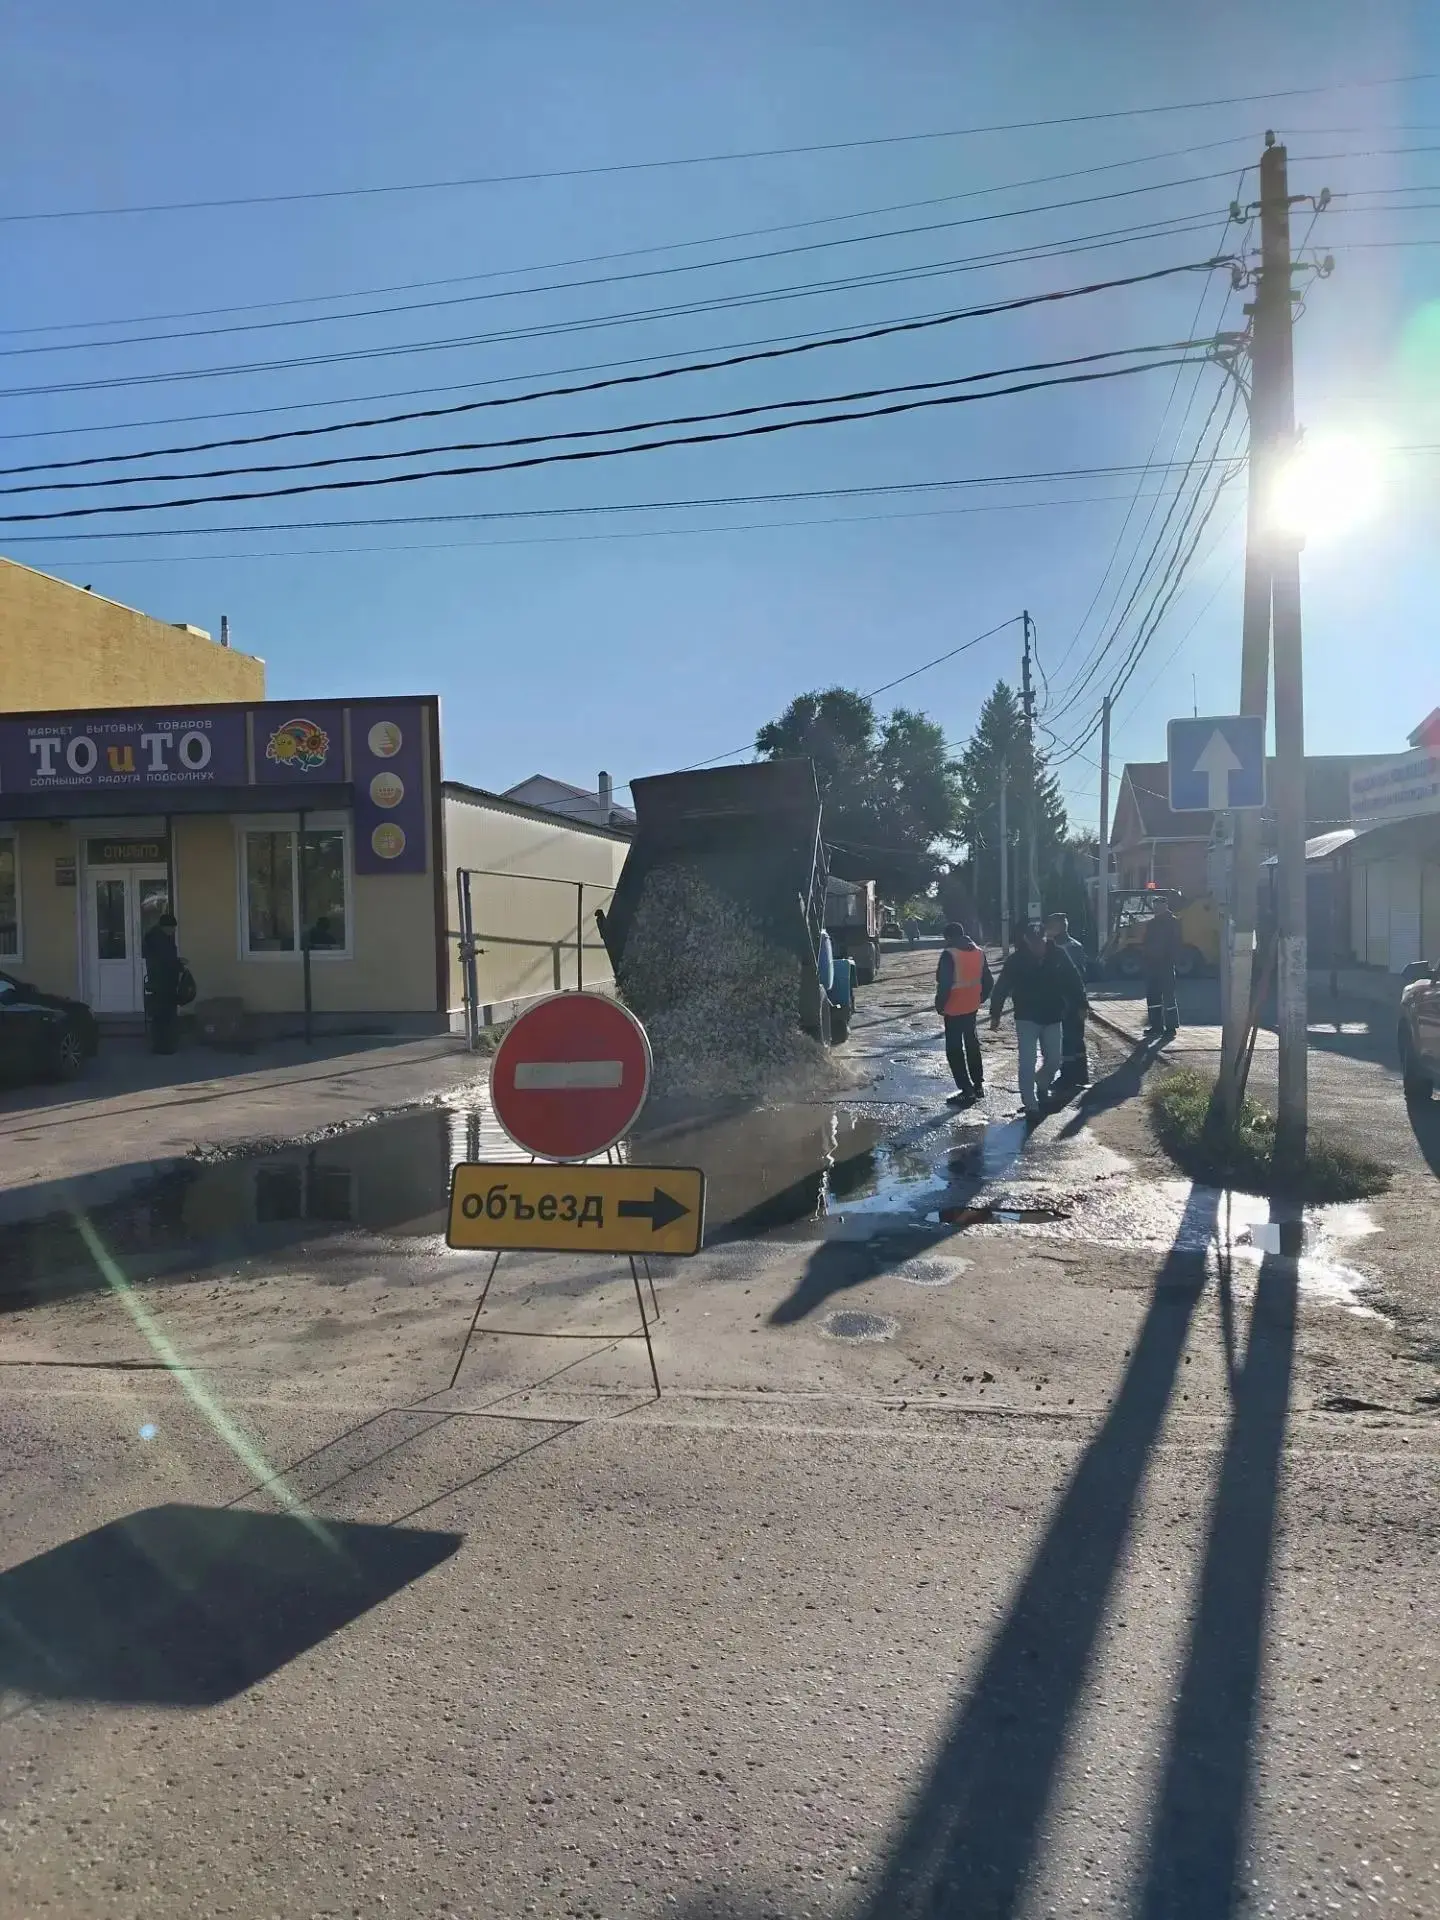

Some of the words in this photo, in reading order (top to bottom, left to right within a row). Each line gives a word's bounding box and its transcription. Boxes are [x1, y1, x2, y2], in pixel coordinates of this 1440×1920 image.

[27, 726, 72, 736] МАРКЕТ
[86, 722, 144, 734] БЫТОВЫХ
[156, 720, 212, 730] ТОВАРОВ
[30, 776, 92, 787] СОЛНЫШКО
[98, 774, 140, 784] РАДУГА
[146, 771, 214, 782] ПОДСОЛНУХ
[461, 1183, 604, 1229] объезд
